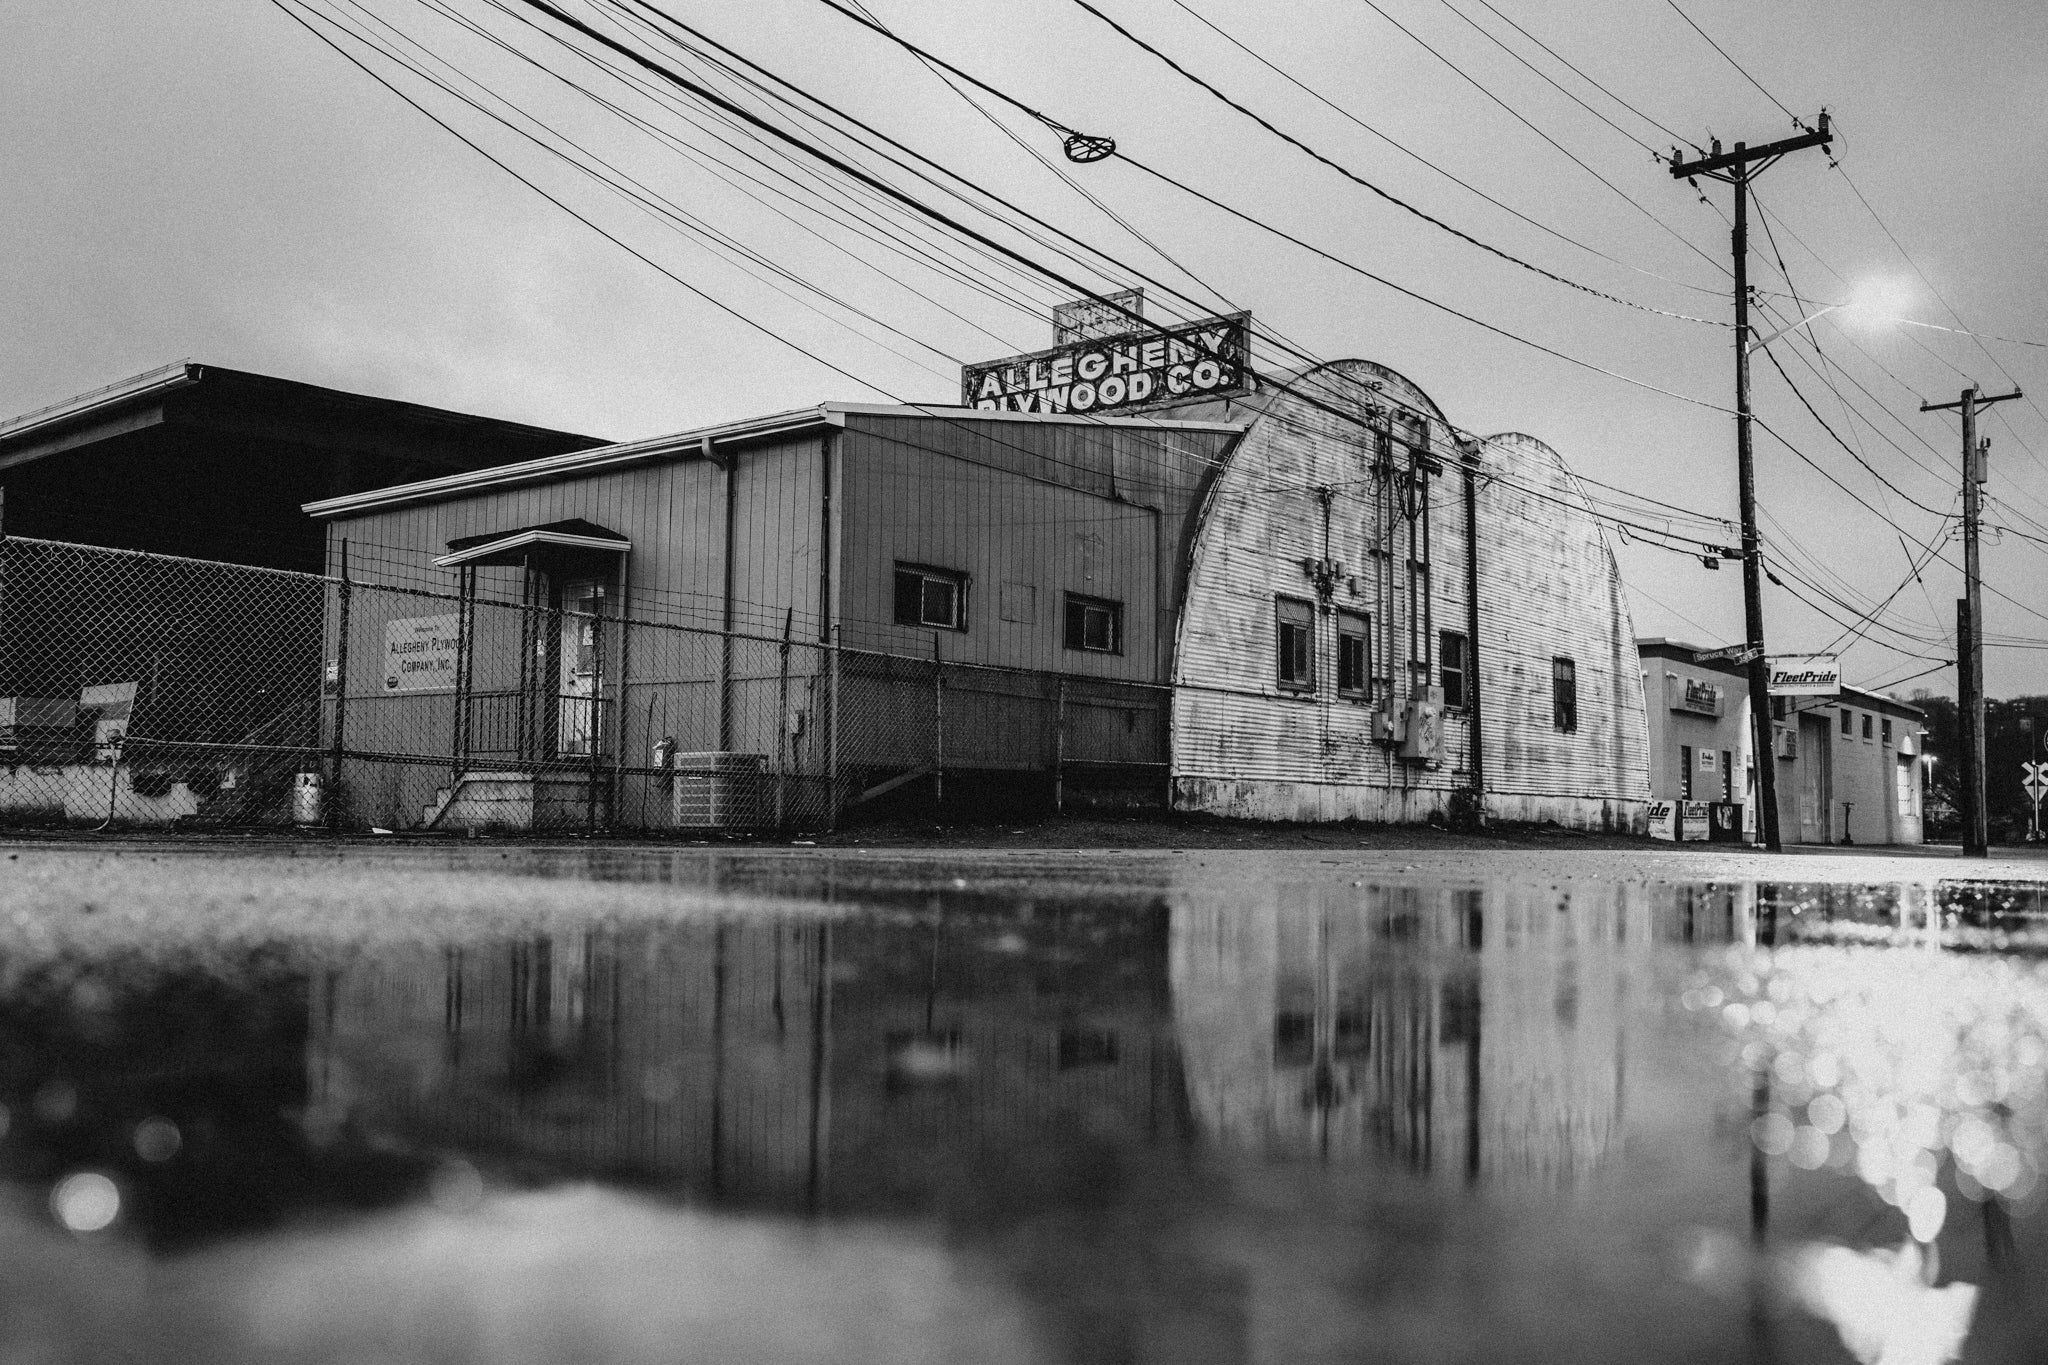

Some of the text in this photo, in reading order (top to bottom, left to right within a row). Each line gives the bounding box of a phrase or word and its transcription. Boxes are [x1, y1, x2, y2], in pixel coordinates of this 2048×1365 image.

[979, 327, 1230, 399] ALLEGHENY
[1167, 360, 1229, 394] CO.
[431, 637, 461, 651] PLYWOO
[1696, 650, 1724, 661] Spruce
[1773, 670, 1837, 683] FleetPride
